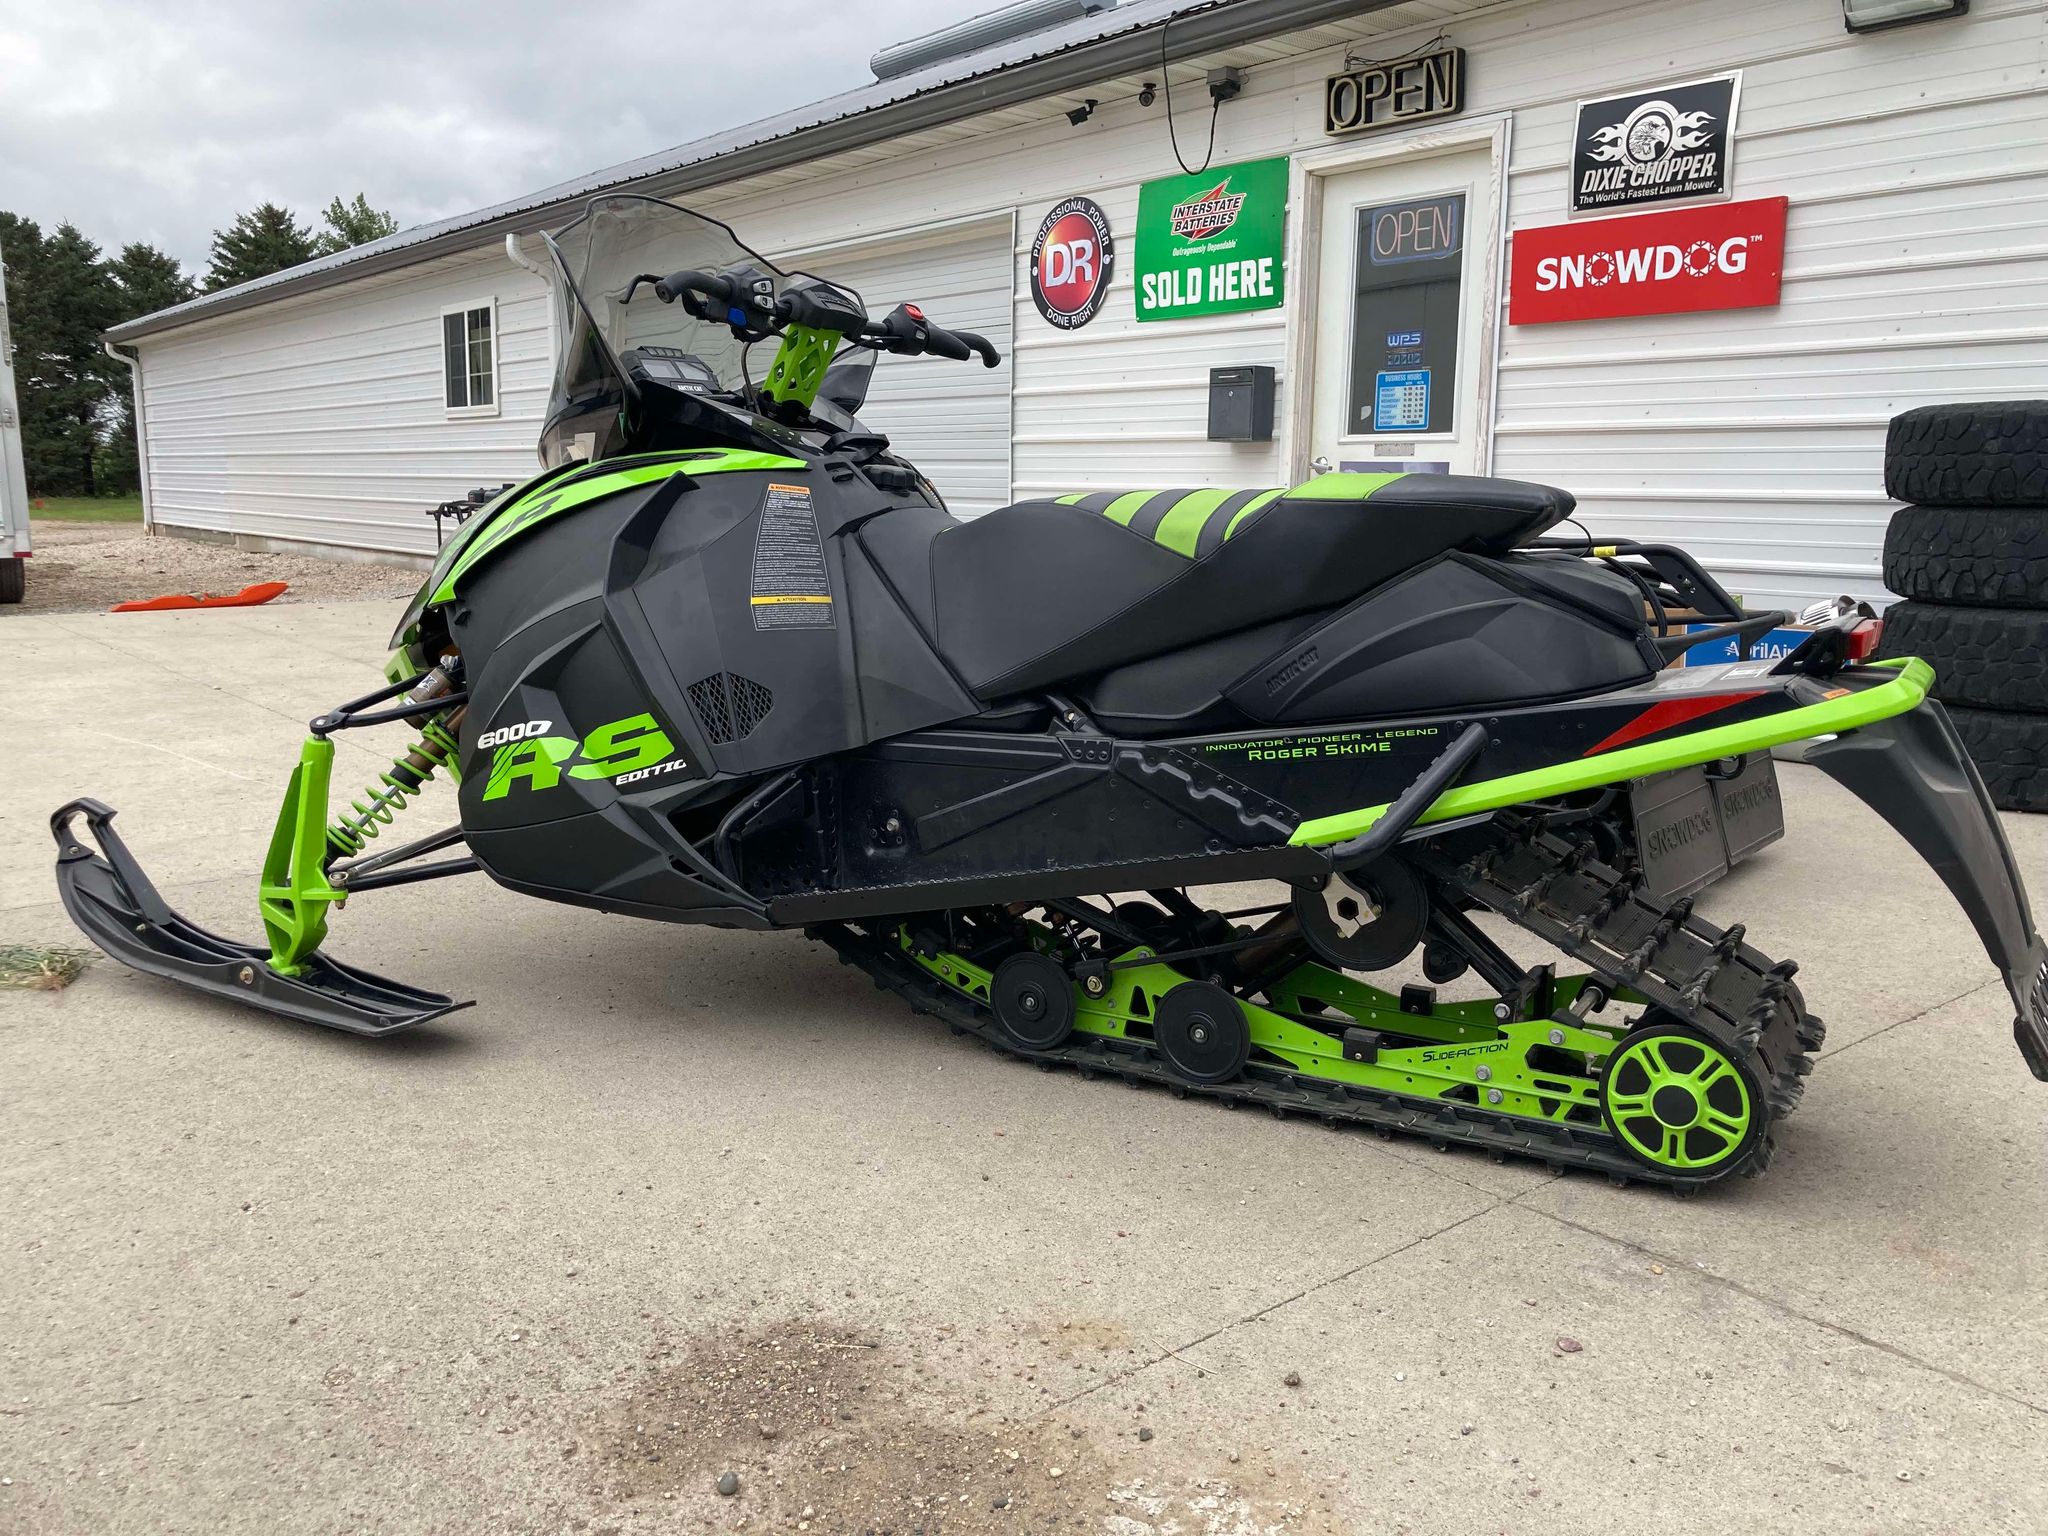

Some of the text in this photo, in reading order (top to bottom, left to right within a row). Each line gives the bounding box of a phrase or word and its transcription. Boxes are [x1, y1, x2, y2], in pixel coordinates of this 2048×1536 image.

[1330, 54, 1450, 127] OPEN
[1580, 152, 1717, 193] DIXIE CHOPPER
[1173, 197, 1242, 218] INTERSTATE
[1579, 196, 1594, 204] The
[1596, 190, 1626, 202] World's
[1627, 187, 1658, 199] Fastest
[1660, 184, 1682, 194] Lawn
[1033, 200, 1110, 257] PROFESSIONAL POWER
[1175, 212, 1235, 232] BATTERIES
[1376, 204, 1452, 256] OPEN
[1045, 239, 1093, 288] DR
[1535, 236, 1749, 292] SNOWDOG
[1142, 257, 1274, 310] SOLD HERE
[1046, 302, 1094, 327] DONE RIGHT
[1387, 333, 1421, 347] WPS
[1205, 739, 1284, 752] INNOVATOR
[1297, 733, 1361, 745] PIONEER
[1376, 727, 1438, 739] LEGEND
[1248, 741, 1391, 761] ROGER SKIME
